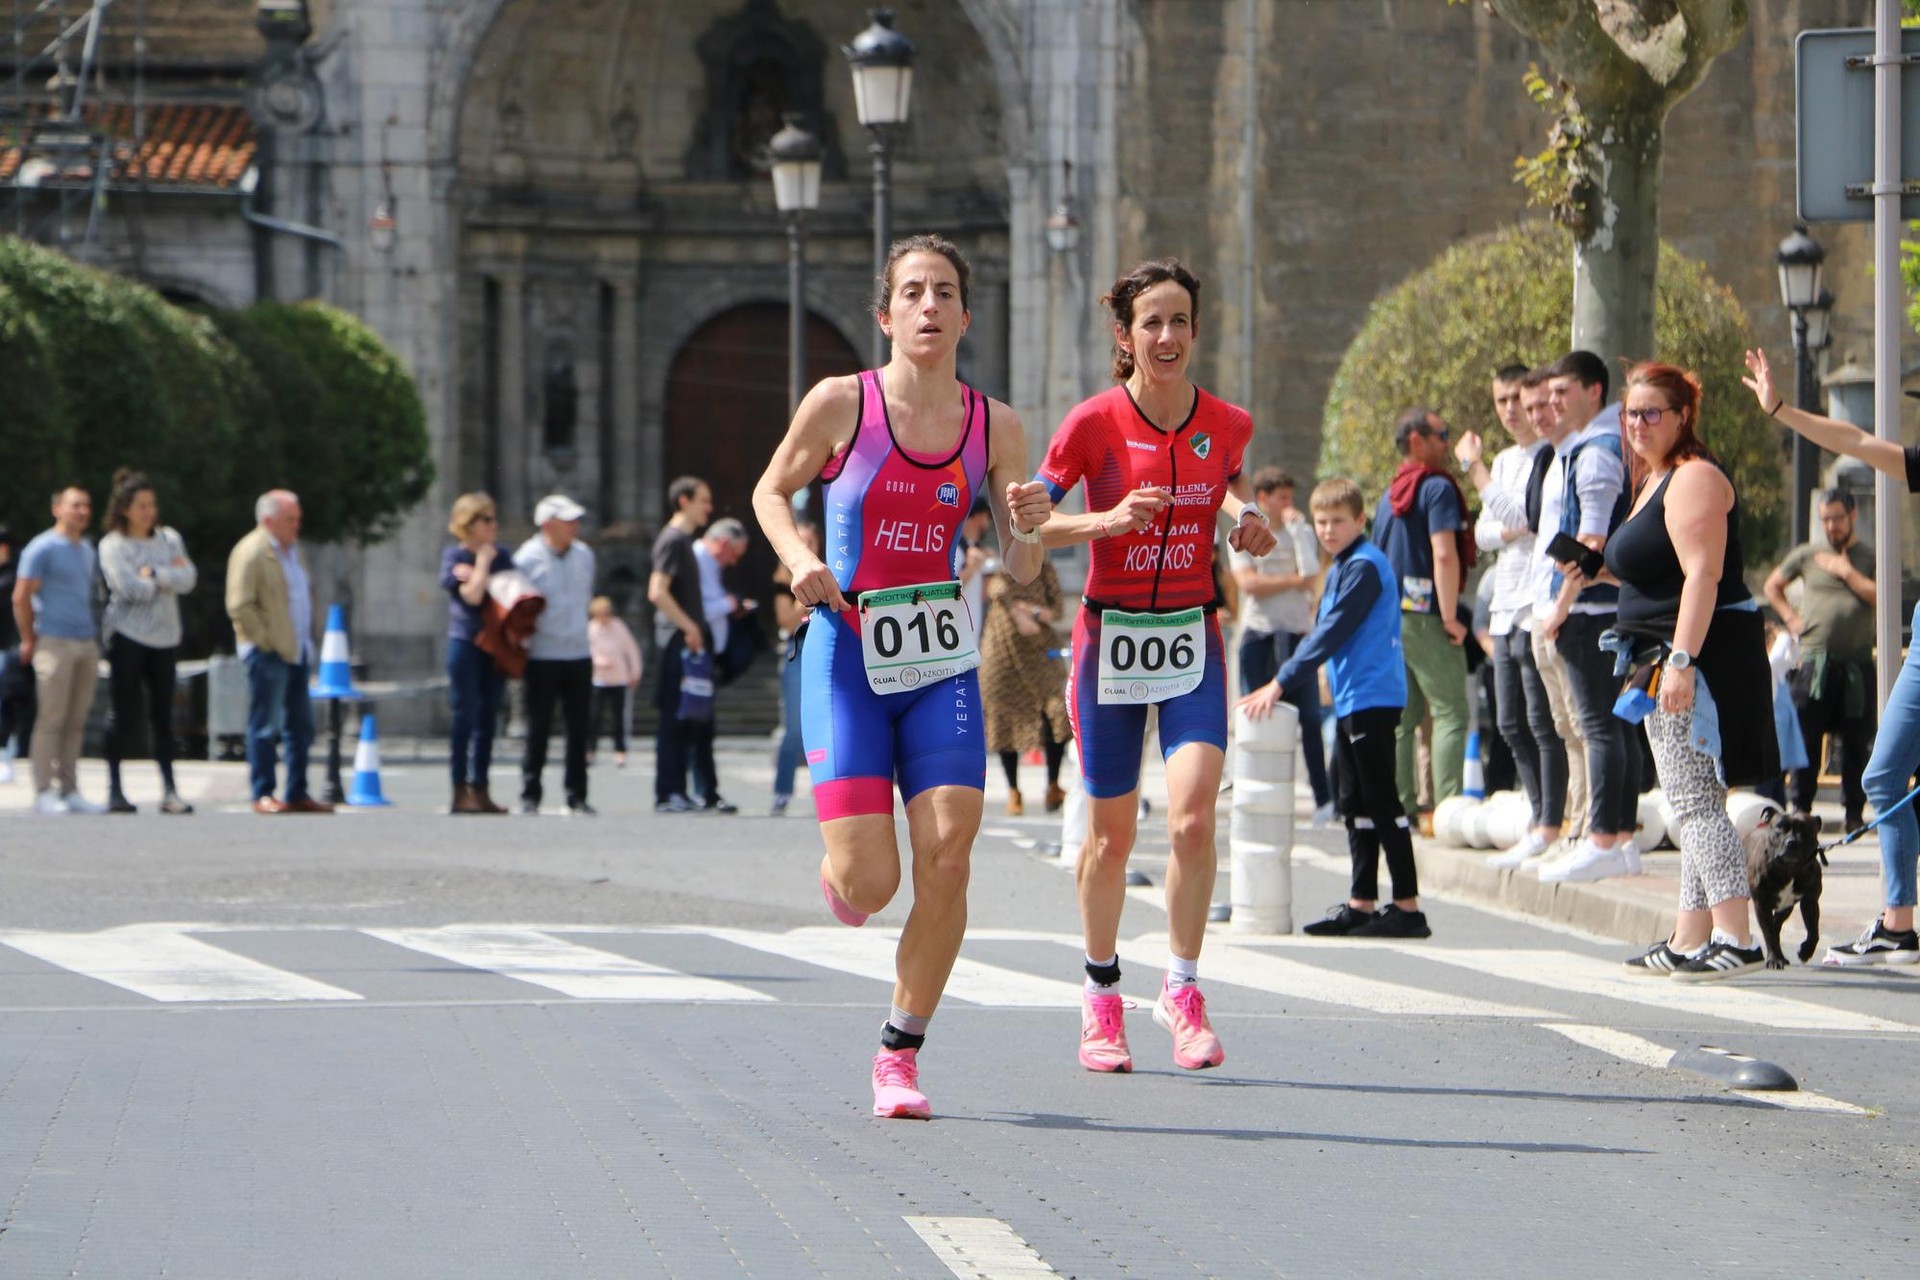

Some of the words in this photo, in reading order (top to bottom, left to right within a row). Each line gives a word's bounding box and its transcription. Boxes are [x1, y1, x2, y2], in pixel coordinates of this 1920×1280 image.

[886, 480, 915, 494] GOBIK
[1140, 480, 1208, 494] MGDALENA
[835, 502, 849, 582] PATRI
[874, 518, 945, 553] HELIS
[1123, 543, 1196, 572] KORKOS
[873, 608, 960, 659] 016
[1110, 633, 1195, 672] 006
